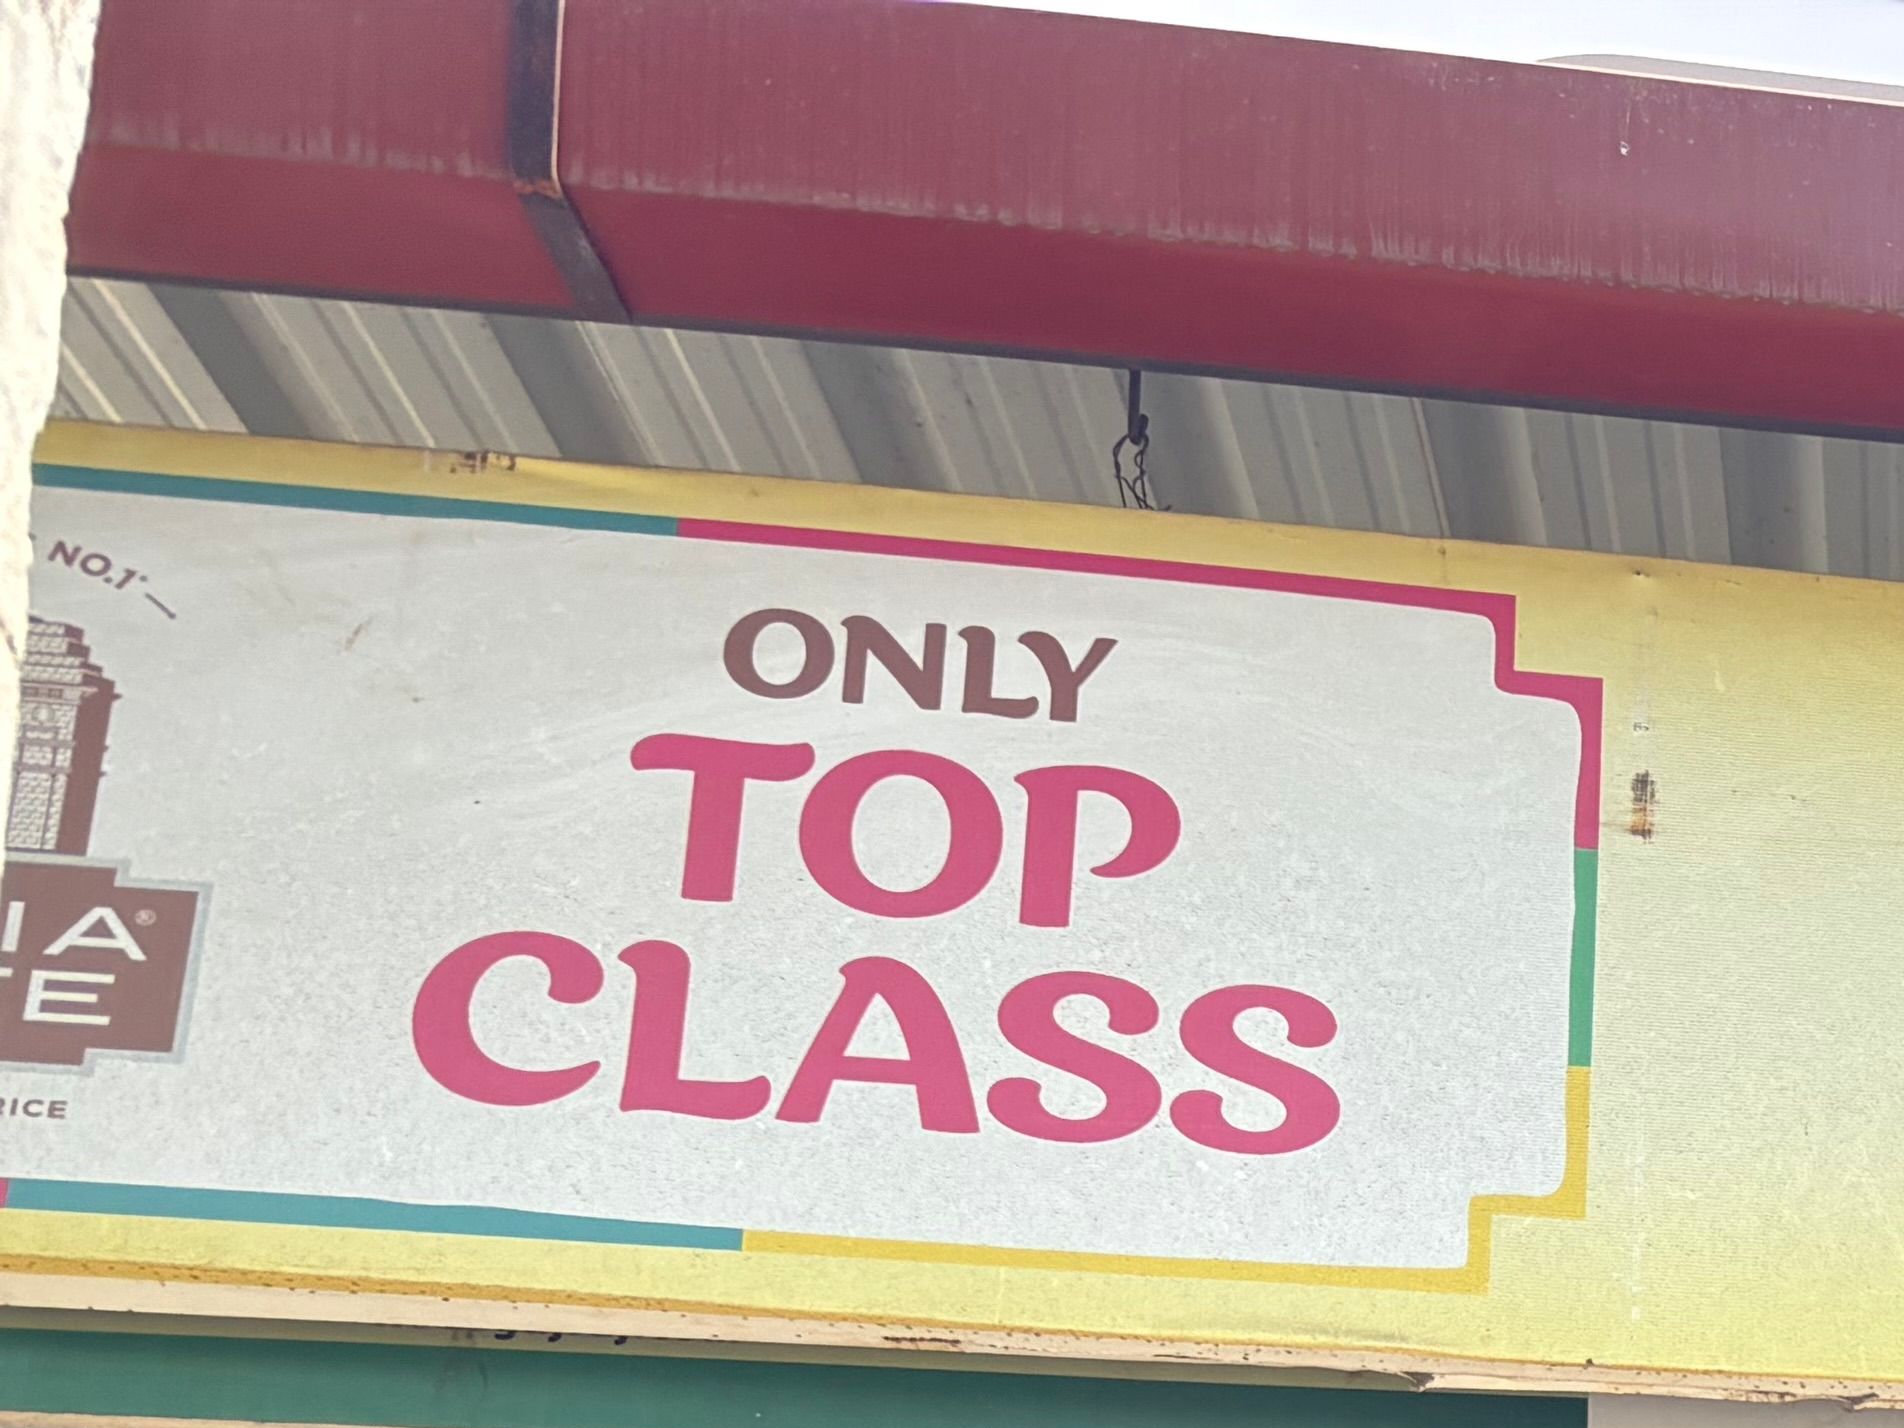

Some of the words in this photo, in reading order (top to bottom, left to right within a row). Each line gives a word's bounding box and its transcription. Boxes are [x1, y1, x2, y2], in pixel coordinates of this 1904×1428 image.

[724, 606, 1117, 723] ONLY
[631, 732, 1182, 929] TOP
[412, 929, 1342, 1155] CLASS
